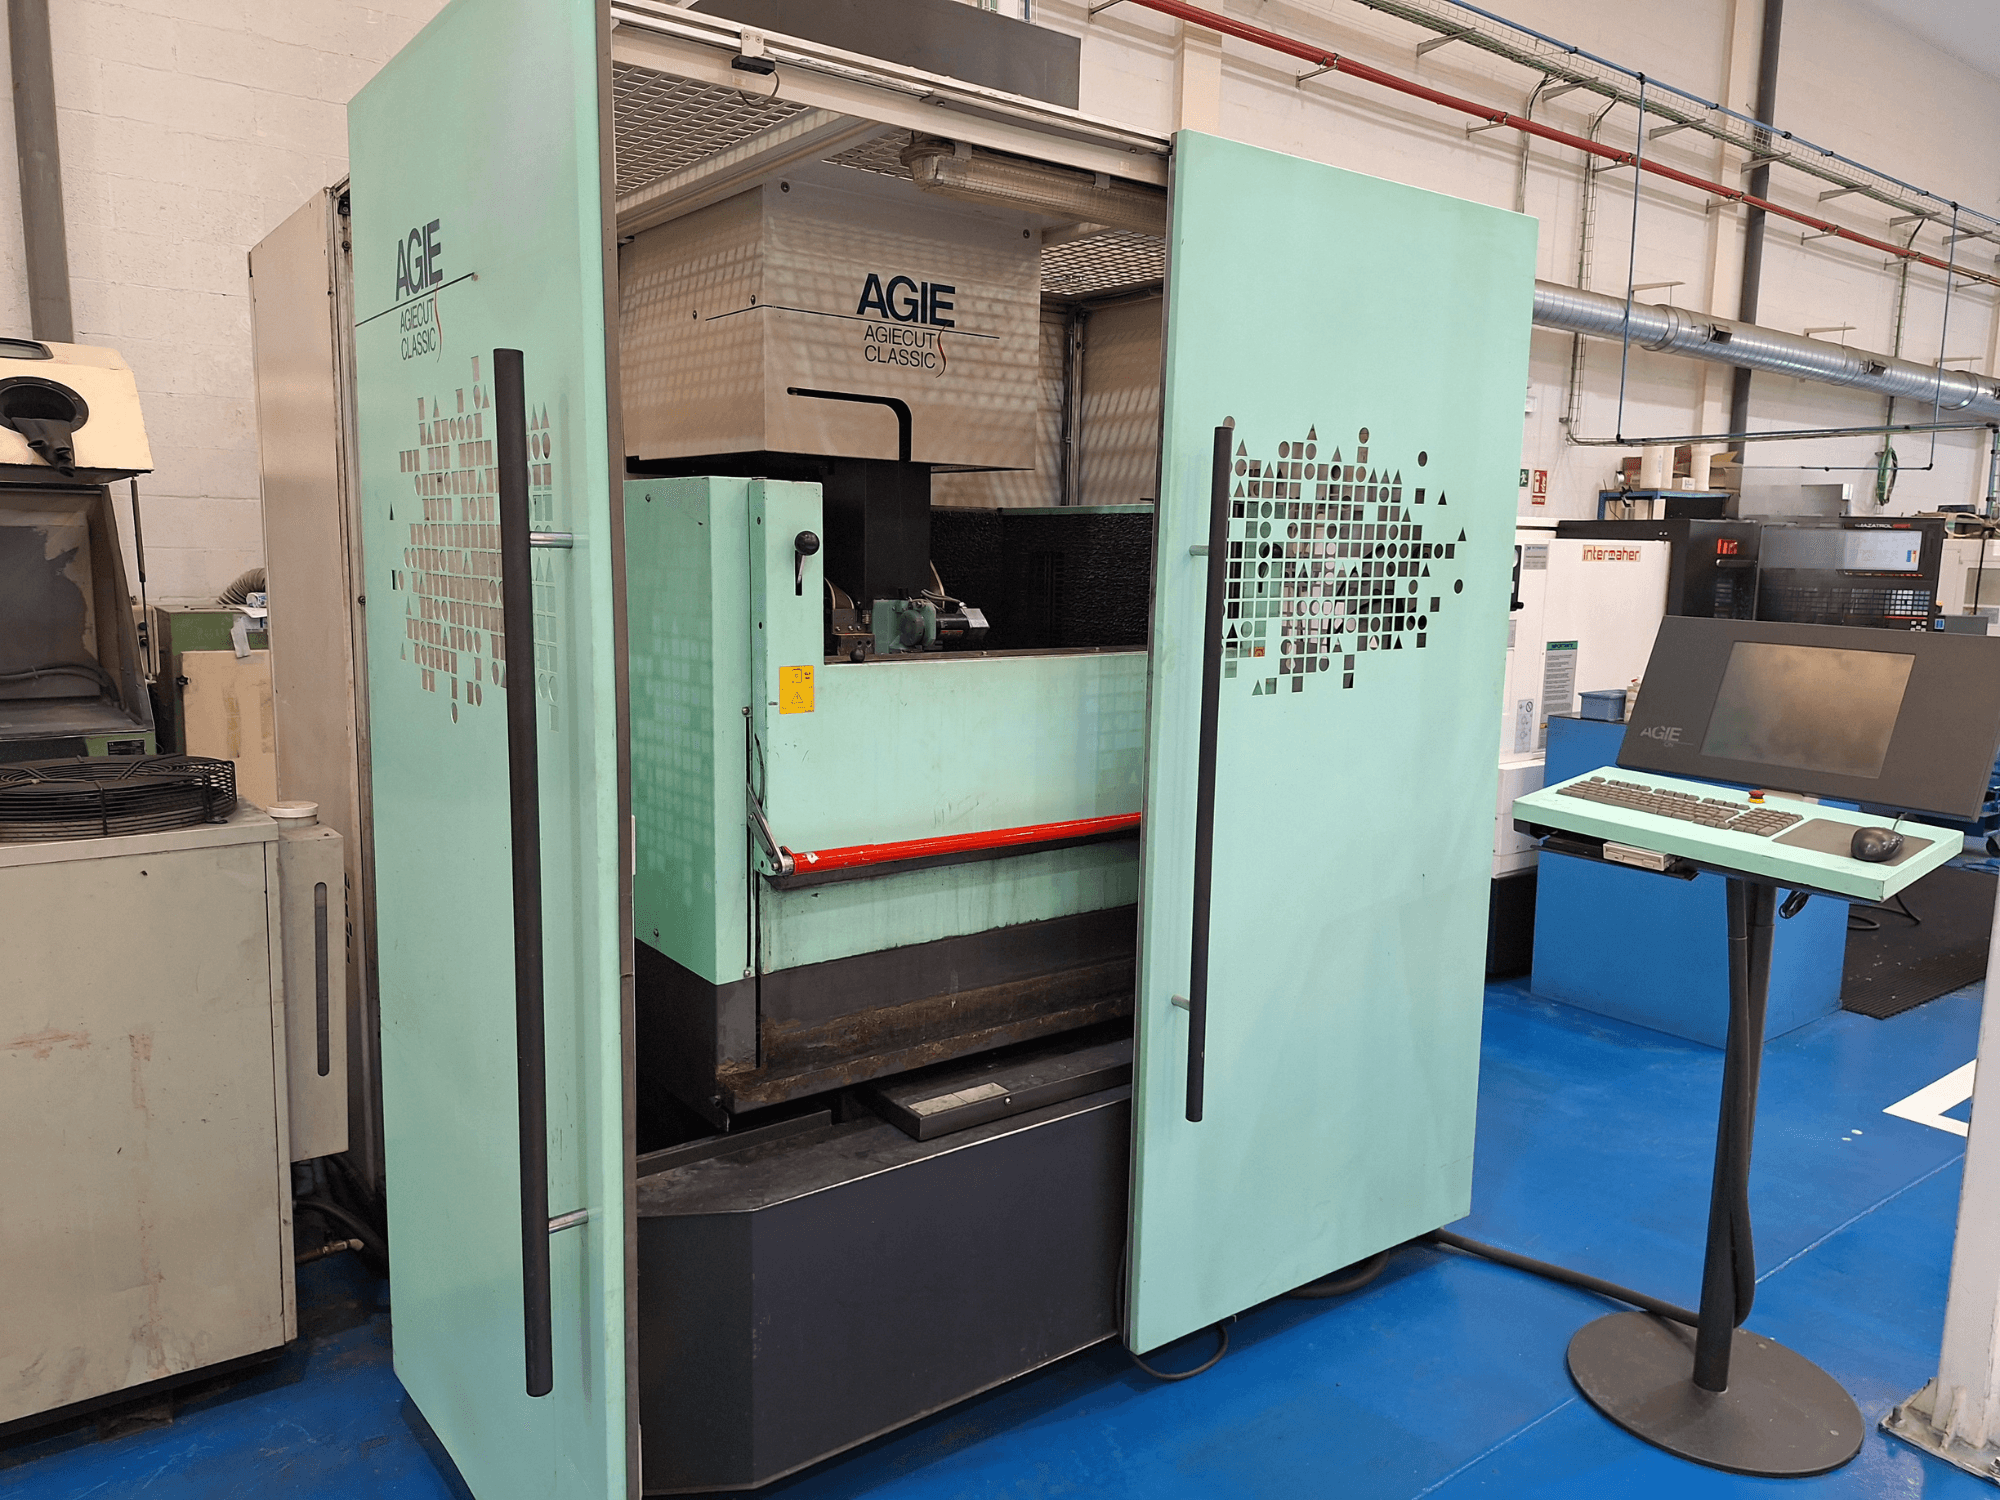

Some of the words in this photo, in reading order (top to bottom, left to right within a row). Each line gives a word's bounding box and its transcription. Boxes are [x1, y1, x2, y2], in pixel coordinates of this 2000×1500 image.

[396, 218, 443, 301] AGIE
[856, 273, 956, 328] AGIE
[400, 298, 434, 334] AGIECUT
[401, 327, 436, 361] CLASSIC
[864, 325, 936, 349] AGIECUT
[864, 345, 936, 369] CLASSIC
[1583, 546, 1640, 561] intermaher
[1640, 725, 1683, 742] AGIE
